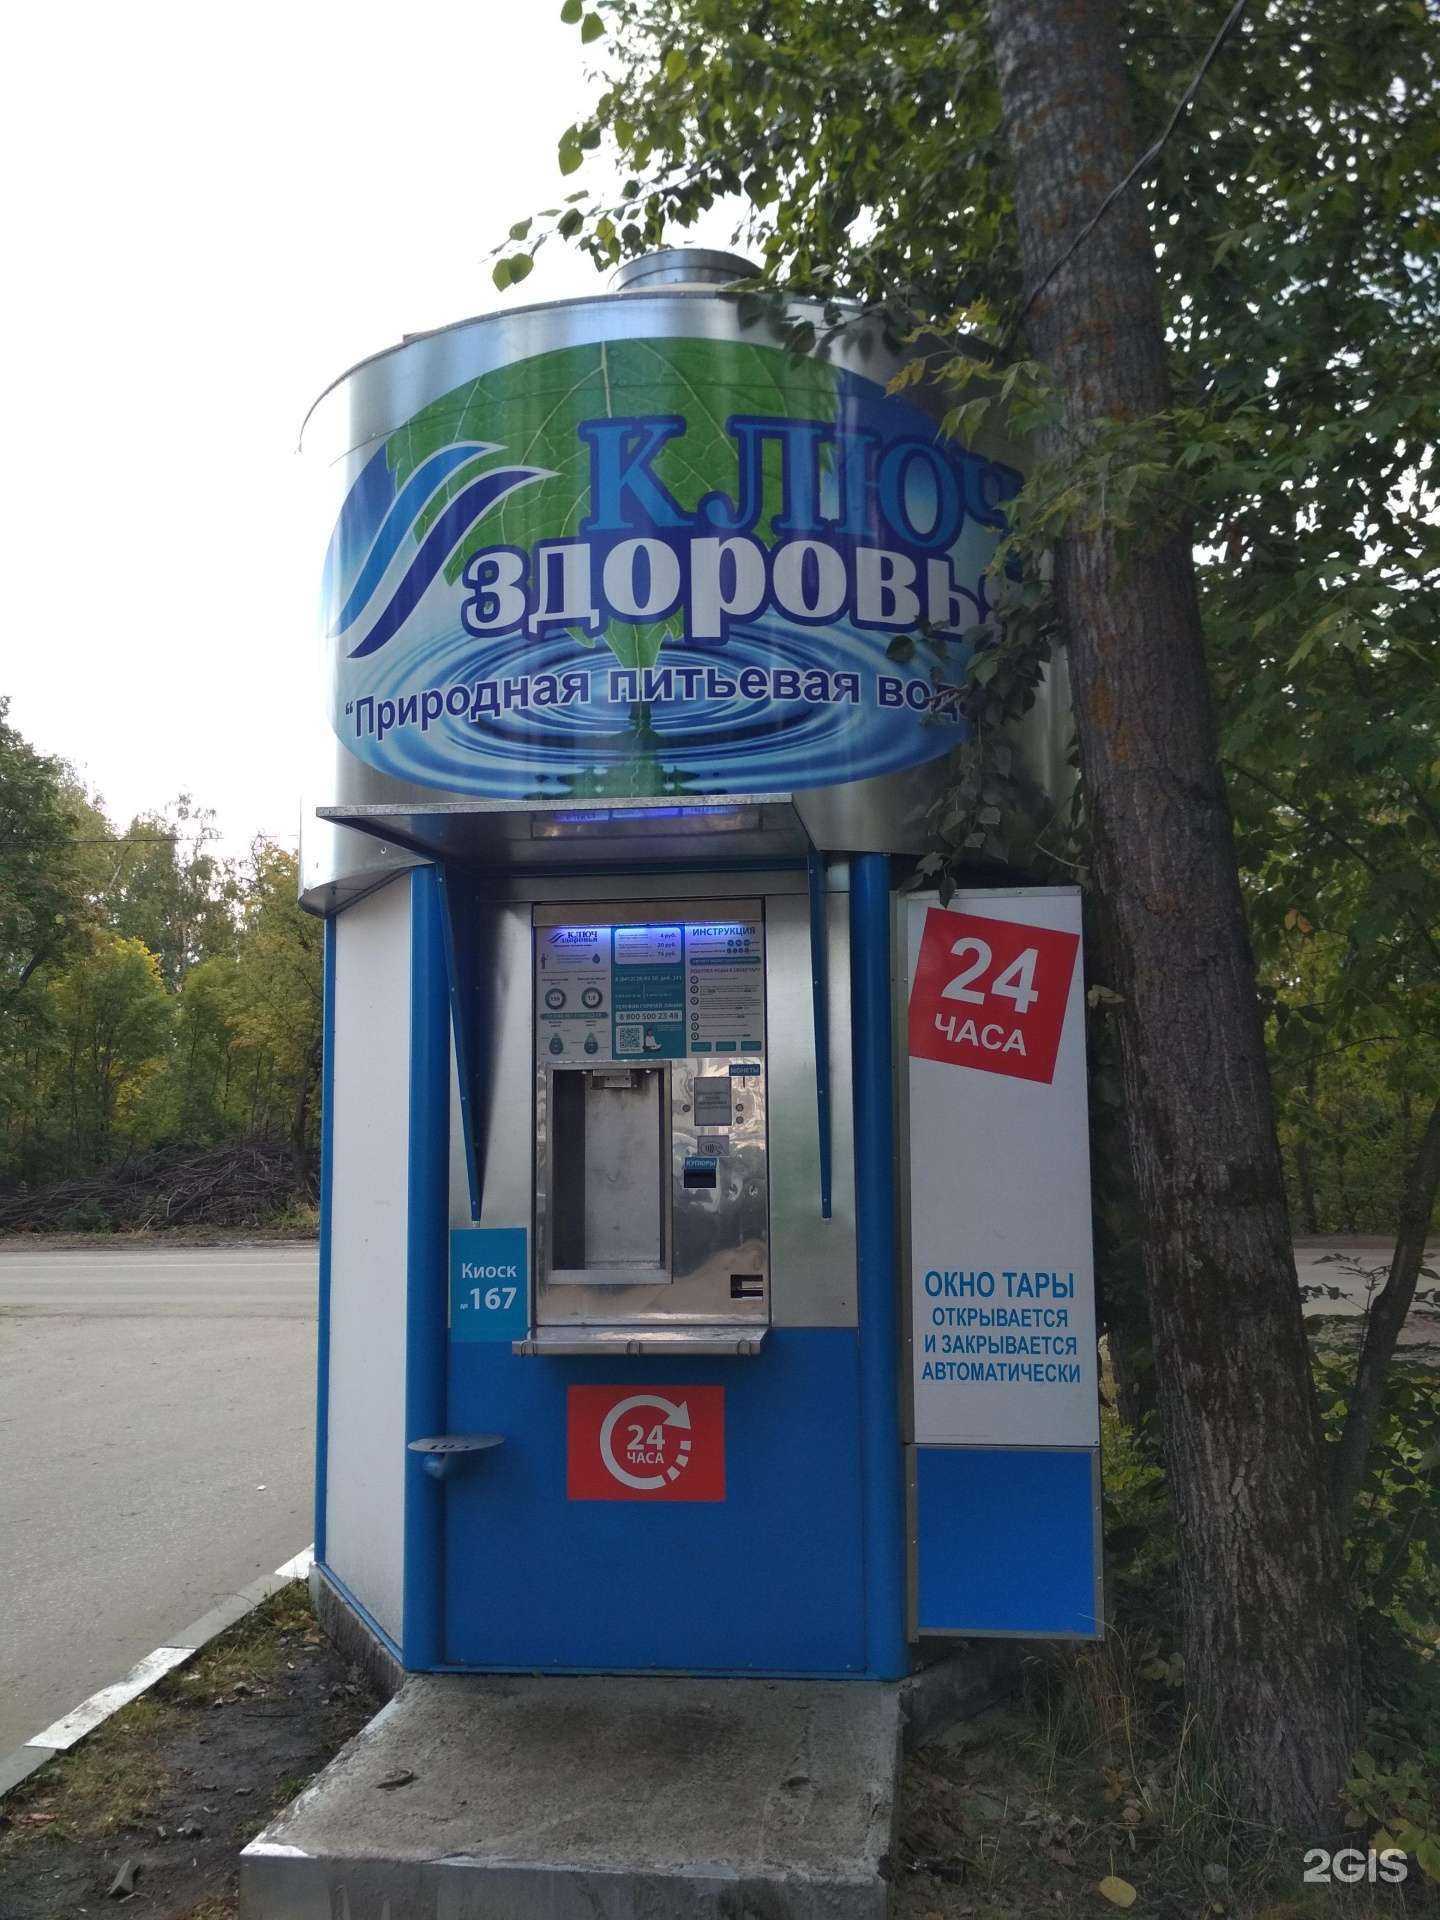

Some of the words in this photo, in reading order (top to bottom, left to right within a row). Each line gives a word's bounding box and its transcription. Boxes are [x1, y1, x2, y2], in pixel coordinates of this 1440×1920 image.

[608, 663, 861, 704] питьевая
[876, 674, 962, 723] вод
[567, 930, 598, 938] КЛЮЧ
[941, 936, 1038, 1014] 24
[934, 1012, 1027, 1056] ЧАСА
[686, 1159, 716, 1168] КУПЮРЫ
[461, 1262, 517, 1279] Киоск
[924, 1270, 996, 1298] ОКНО
[1002, 1271, 1075, 1298] ТАРЫ
[470, 1287, 517, 1310] 167
[932, 1307, 1069, 1328] ОТКРЫВАЕТСЯ
[924, 1334, 936, 1353] И
[942, 1334, 1078, 1355] ЗАКРЫВАЕТСЯ
[922, 1361, 1081, 1383] АВТОМАТИЧЕСКИ
[626, 1424, 665, 1450] 24
[626, 1451, 664, 1465] ЧАСА
